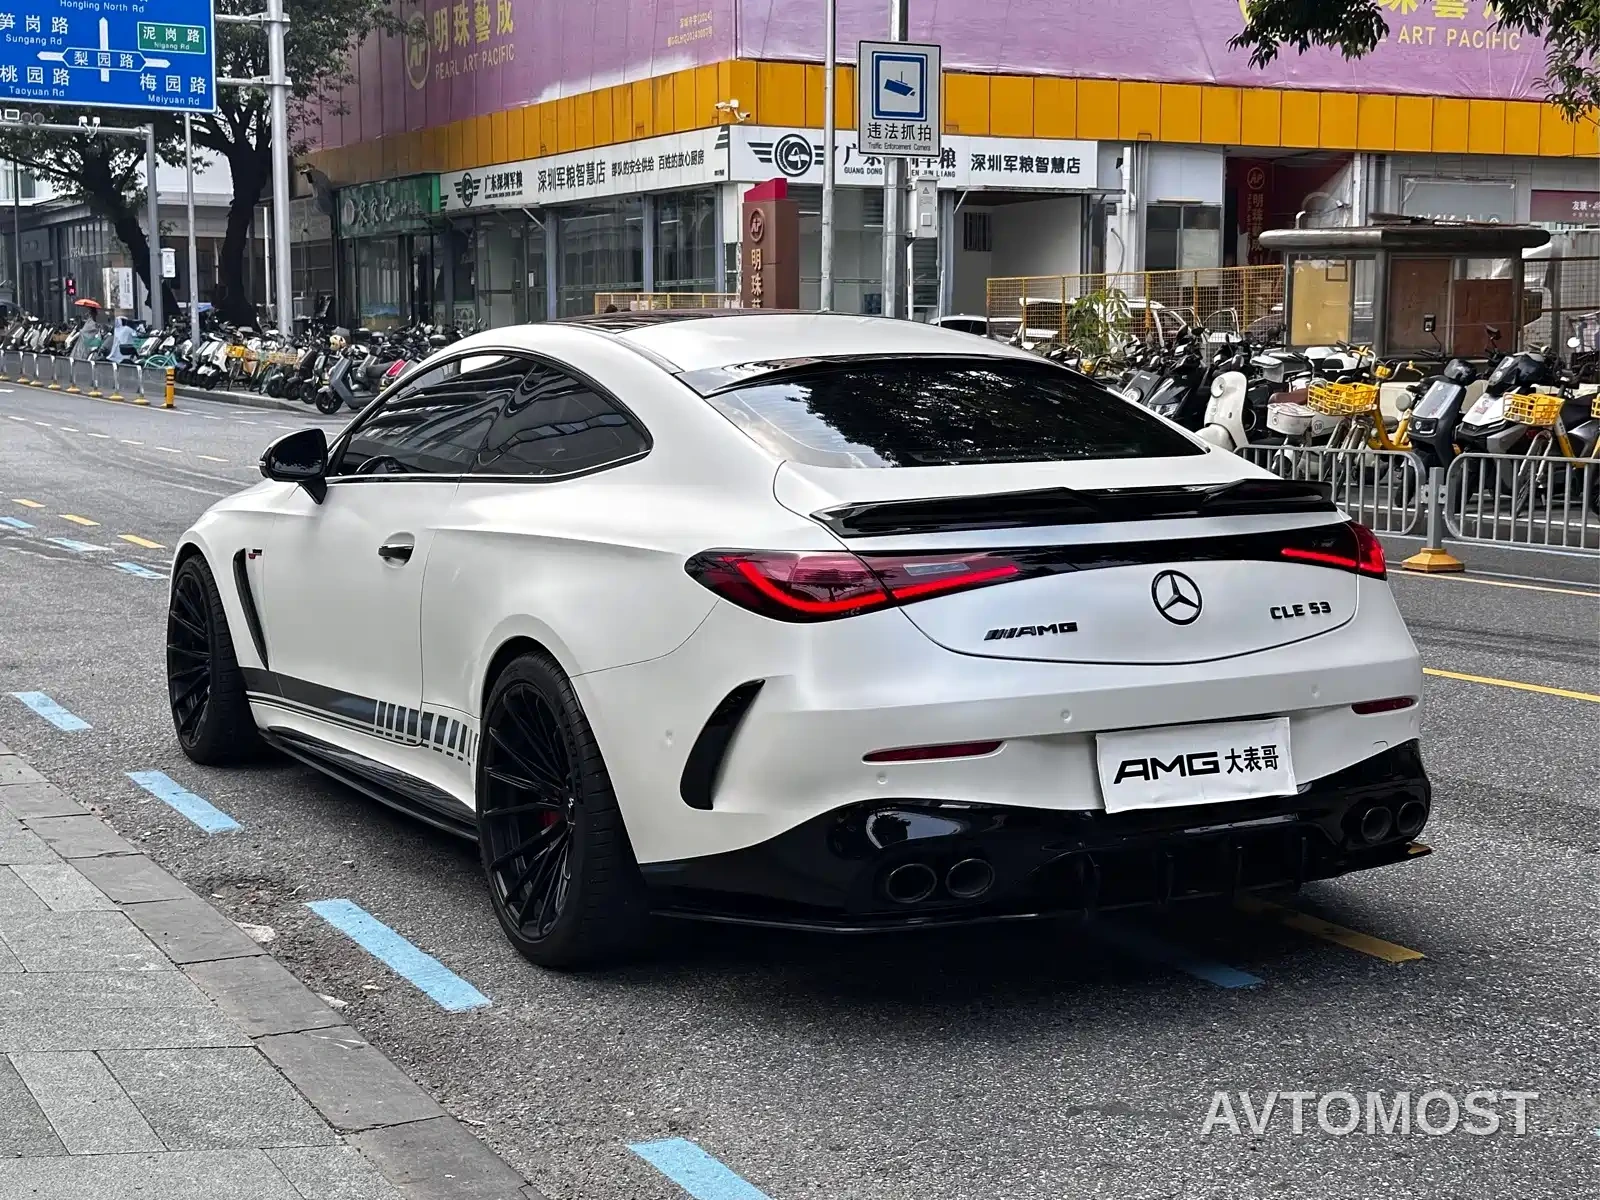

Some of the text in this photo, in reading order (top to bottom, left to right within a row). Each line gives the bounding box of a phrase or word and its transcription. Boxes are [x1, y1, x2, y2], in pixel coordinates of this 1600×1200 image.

[60, 0, 144, 13] Hongling North Rd
[0, 13, 68, 35] 笋岗路
[5, 34, 62, 46] Sungang Rd
[143, 26, 200, 43] 泥岗路
[1398, 24, 1521, 51] ART PACIFIC
[74, 51, 134, 68] 梨园路
[435, 44, 515, 82] PEARL ART PACIFIC
[0, 65, 70, 86] 桃园路
[140, 73, 206, 94] 梅园路
[9, 86, 64, 96] Taoyuan Rd
[148, 94, 199, 105] Meiyuan Rd
[867, 122, 932, 141] 违法抓拍
[971, 153, 1080, 174] 深圳军粮智慧店
[537, 160, 606, 193] 深圳军粮智慧店
[1269, 601, 1331, 620] CLE 53
[1113, 744, 1279, 785] AMG 大表哥
